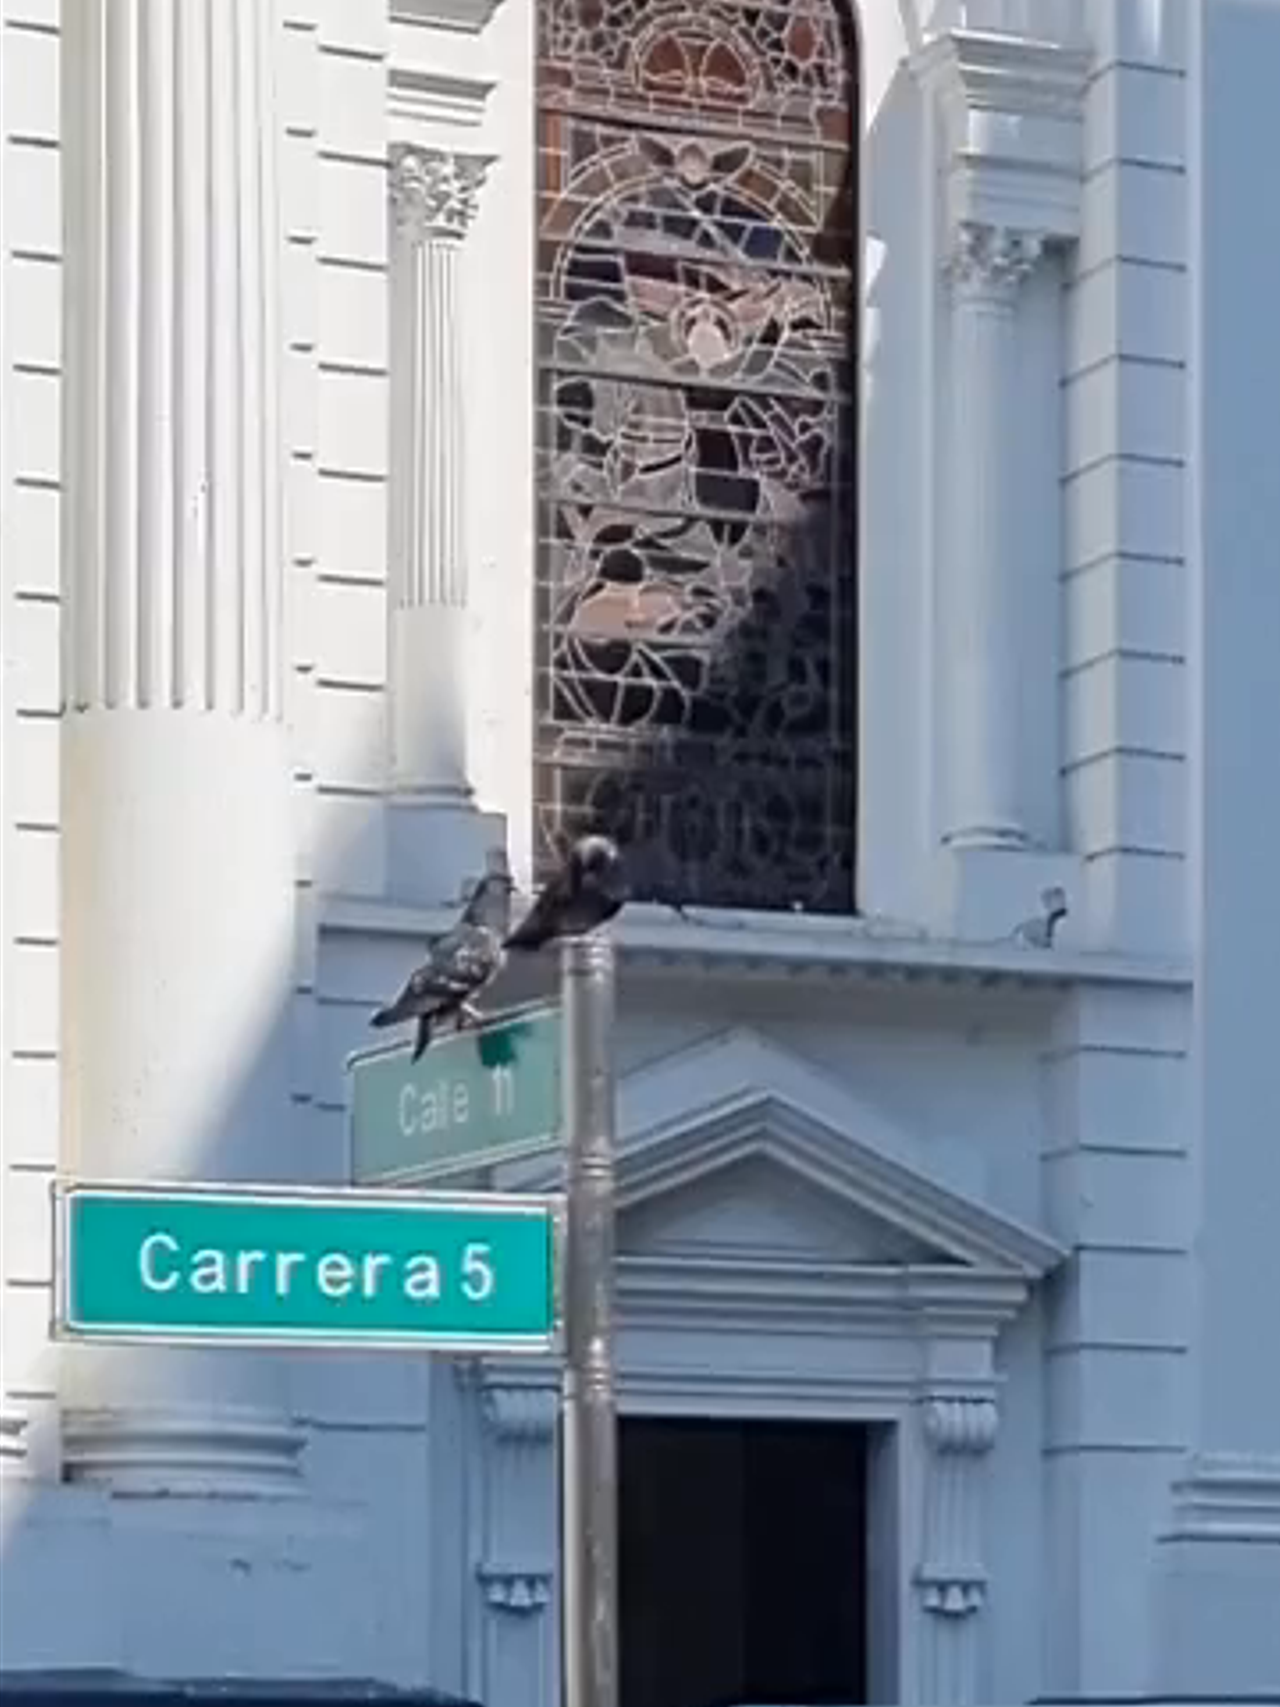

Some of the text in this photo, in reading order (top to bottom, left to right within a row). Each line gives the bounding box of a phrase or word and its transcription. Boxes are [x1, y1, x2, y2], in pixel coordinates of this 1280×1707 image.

[398, 1065, 514, 1137] Calle 11
[138, 1231, 496, 1301] Carrera 5
